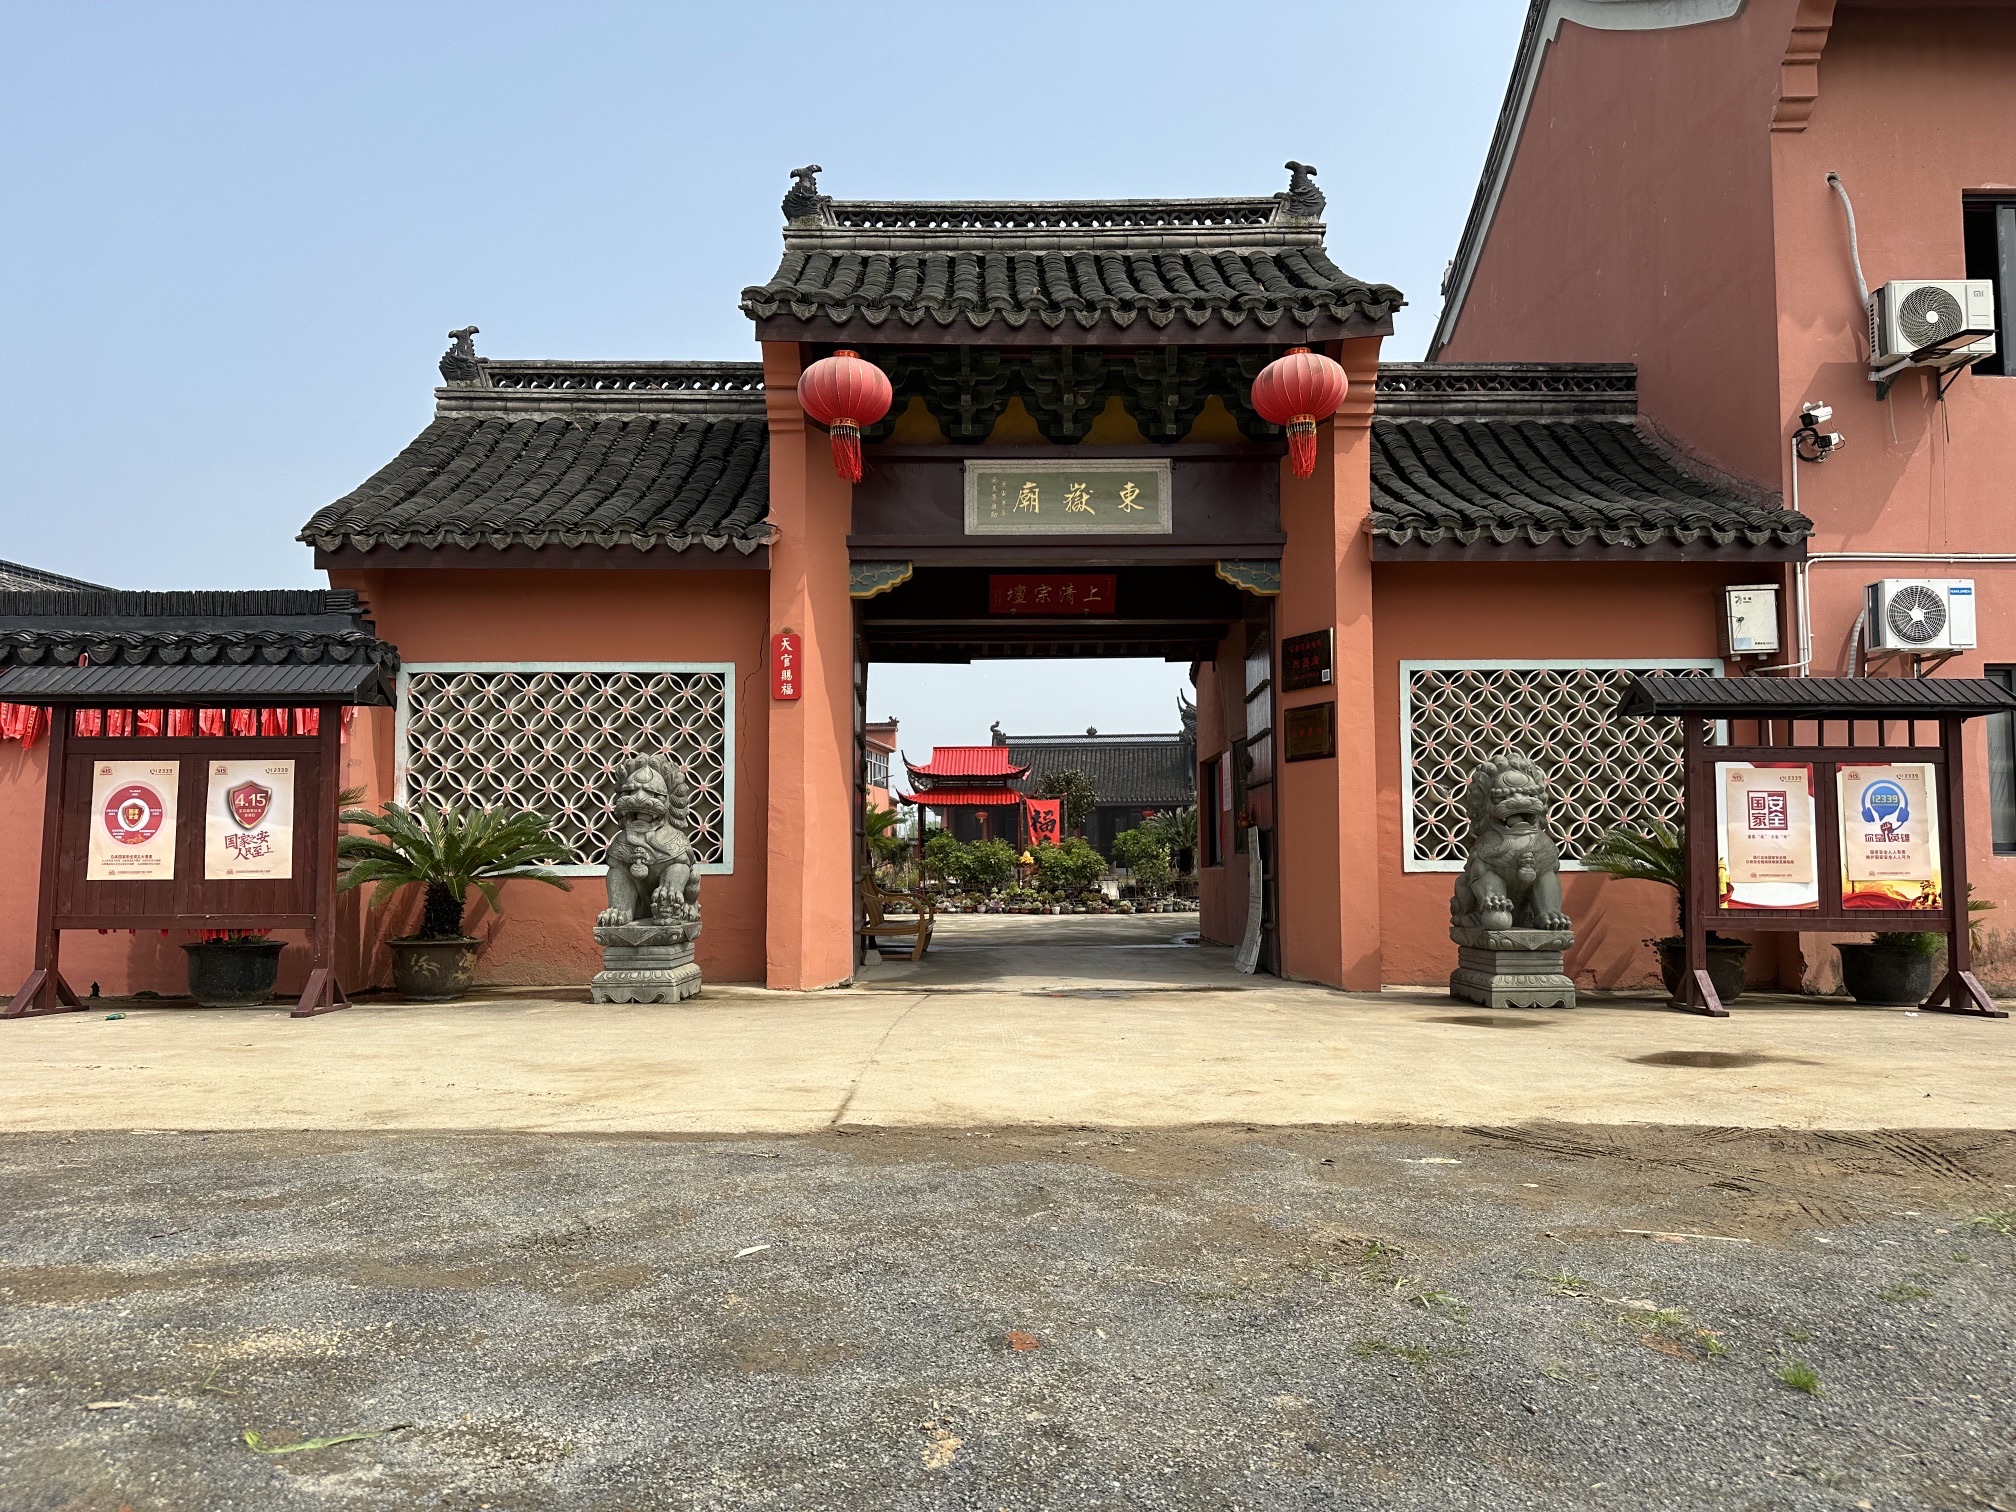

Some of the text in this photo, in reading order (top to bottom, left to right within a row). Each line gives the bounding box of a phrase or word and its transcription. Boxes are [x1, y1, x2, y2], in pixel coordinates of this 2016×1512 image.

[1012, 481, 1145, 516] 東嶽廟
[1007, 582, 1102, 605] 上清宗壇
[780, 637, 794, 696] 天官賜福
[235, 793, 266, 807] 4.15
[1872, 795, 1899, 803] 12339
[224, 830, 270, 849] 国家之安
[233, 845, 274, 861] 人民至上
